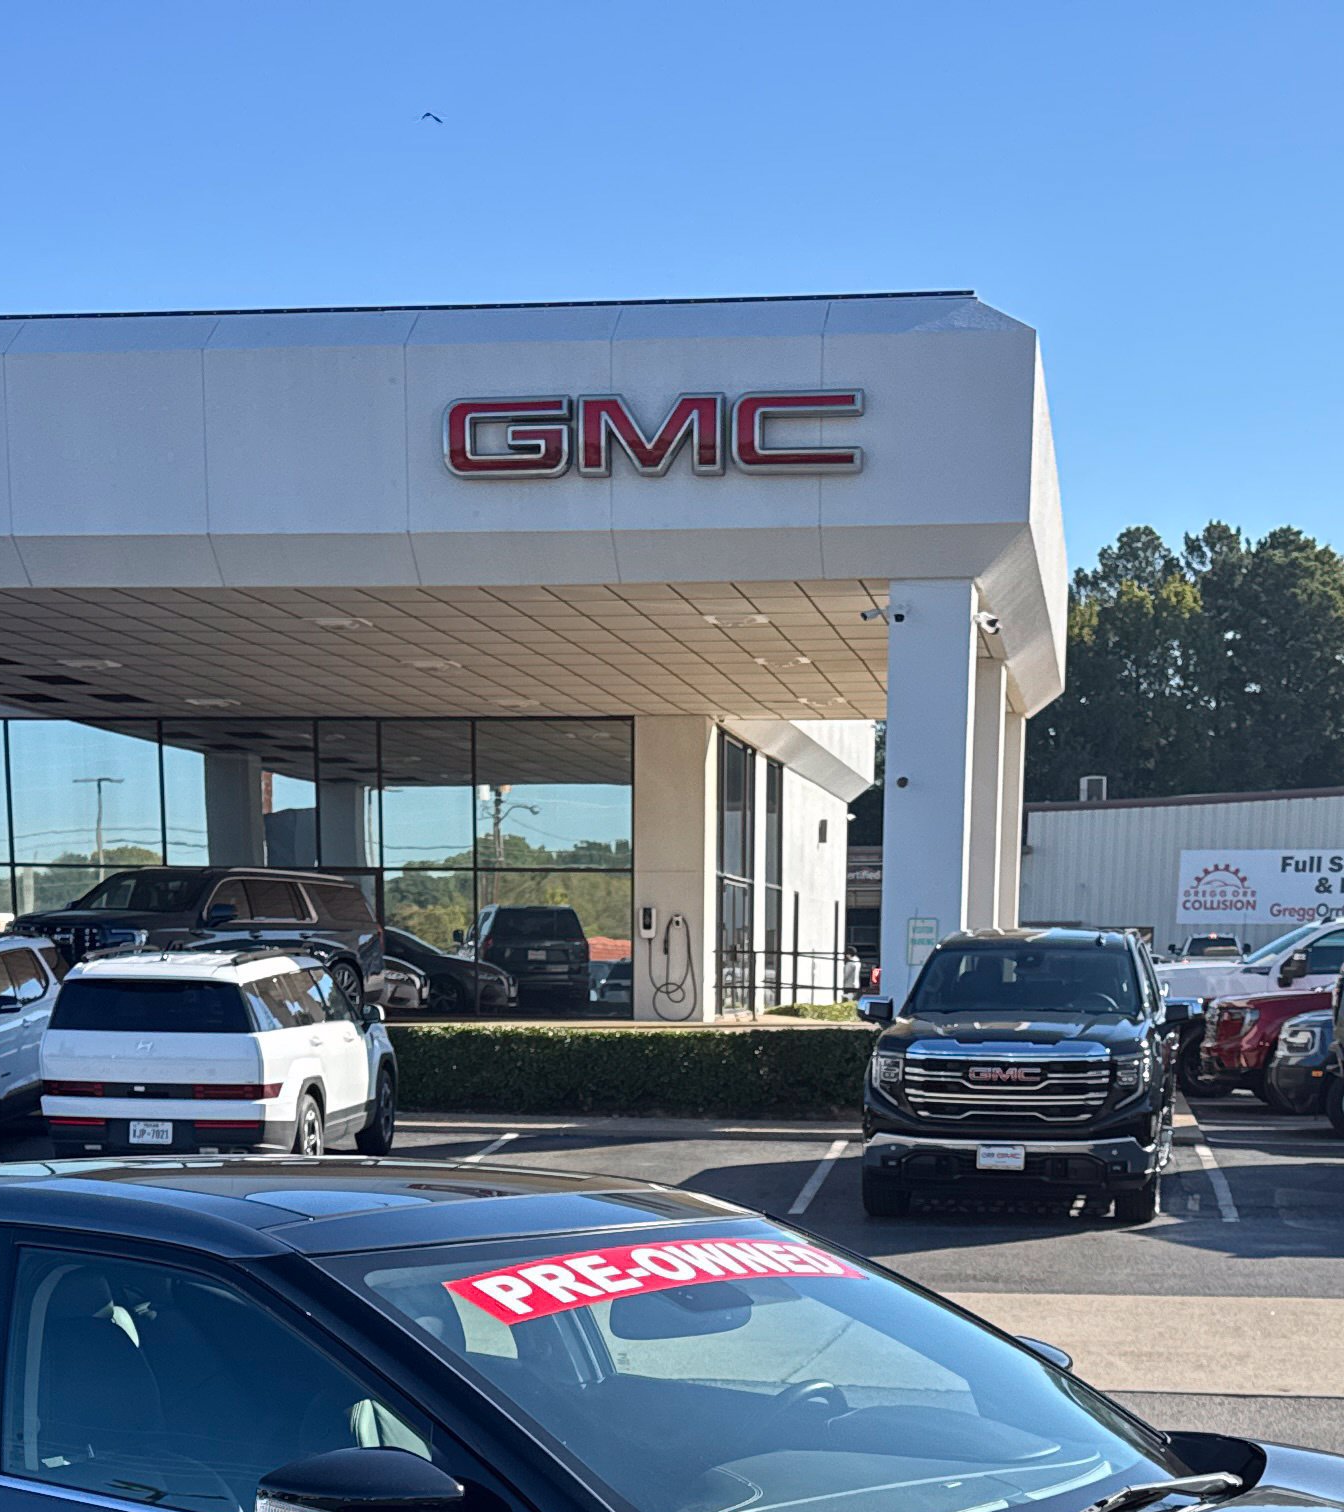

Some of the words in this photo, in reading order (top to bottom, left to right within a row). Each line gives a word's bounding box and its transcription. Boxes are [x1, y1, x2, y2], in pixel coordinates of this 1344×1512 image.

[441, 388, 865, 481] GMC
[1280, 856, 1322, 873] Full
[847, 868, 881, 880] ertified
[1314, 877, 1332, 894] &
[1183, 890, 1227, 898] GREGG
[1182, 900, 1256, 911] COLLISION
[969, 1066, 1041, 1081] GMC
[472, 1243, 844, 1315] PRE-OWNED
